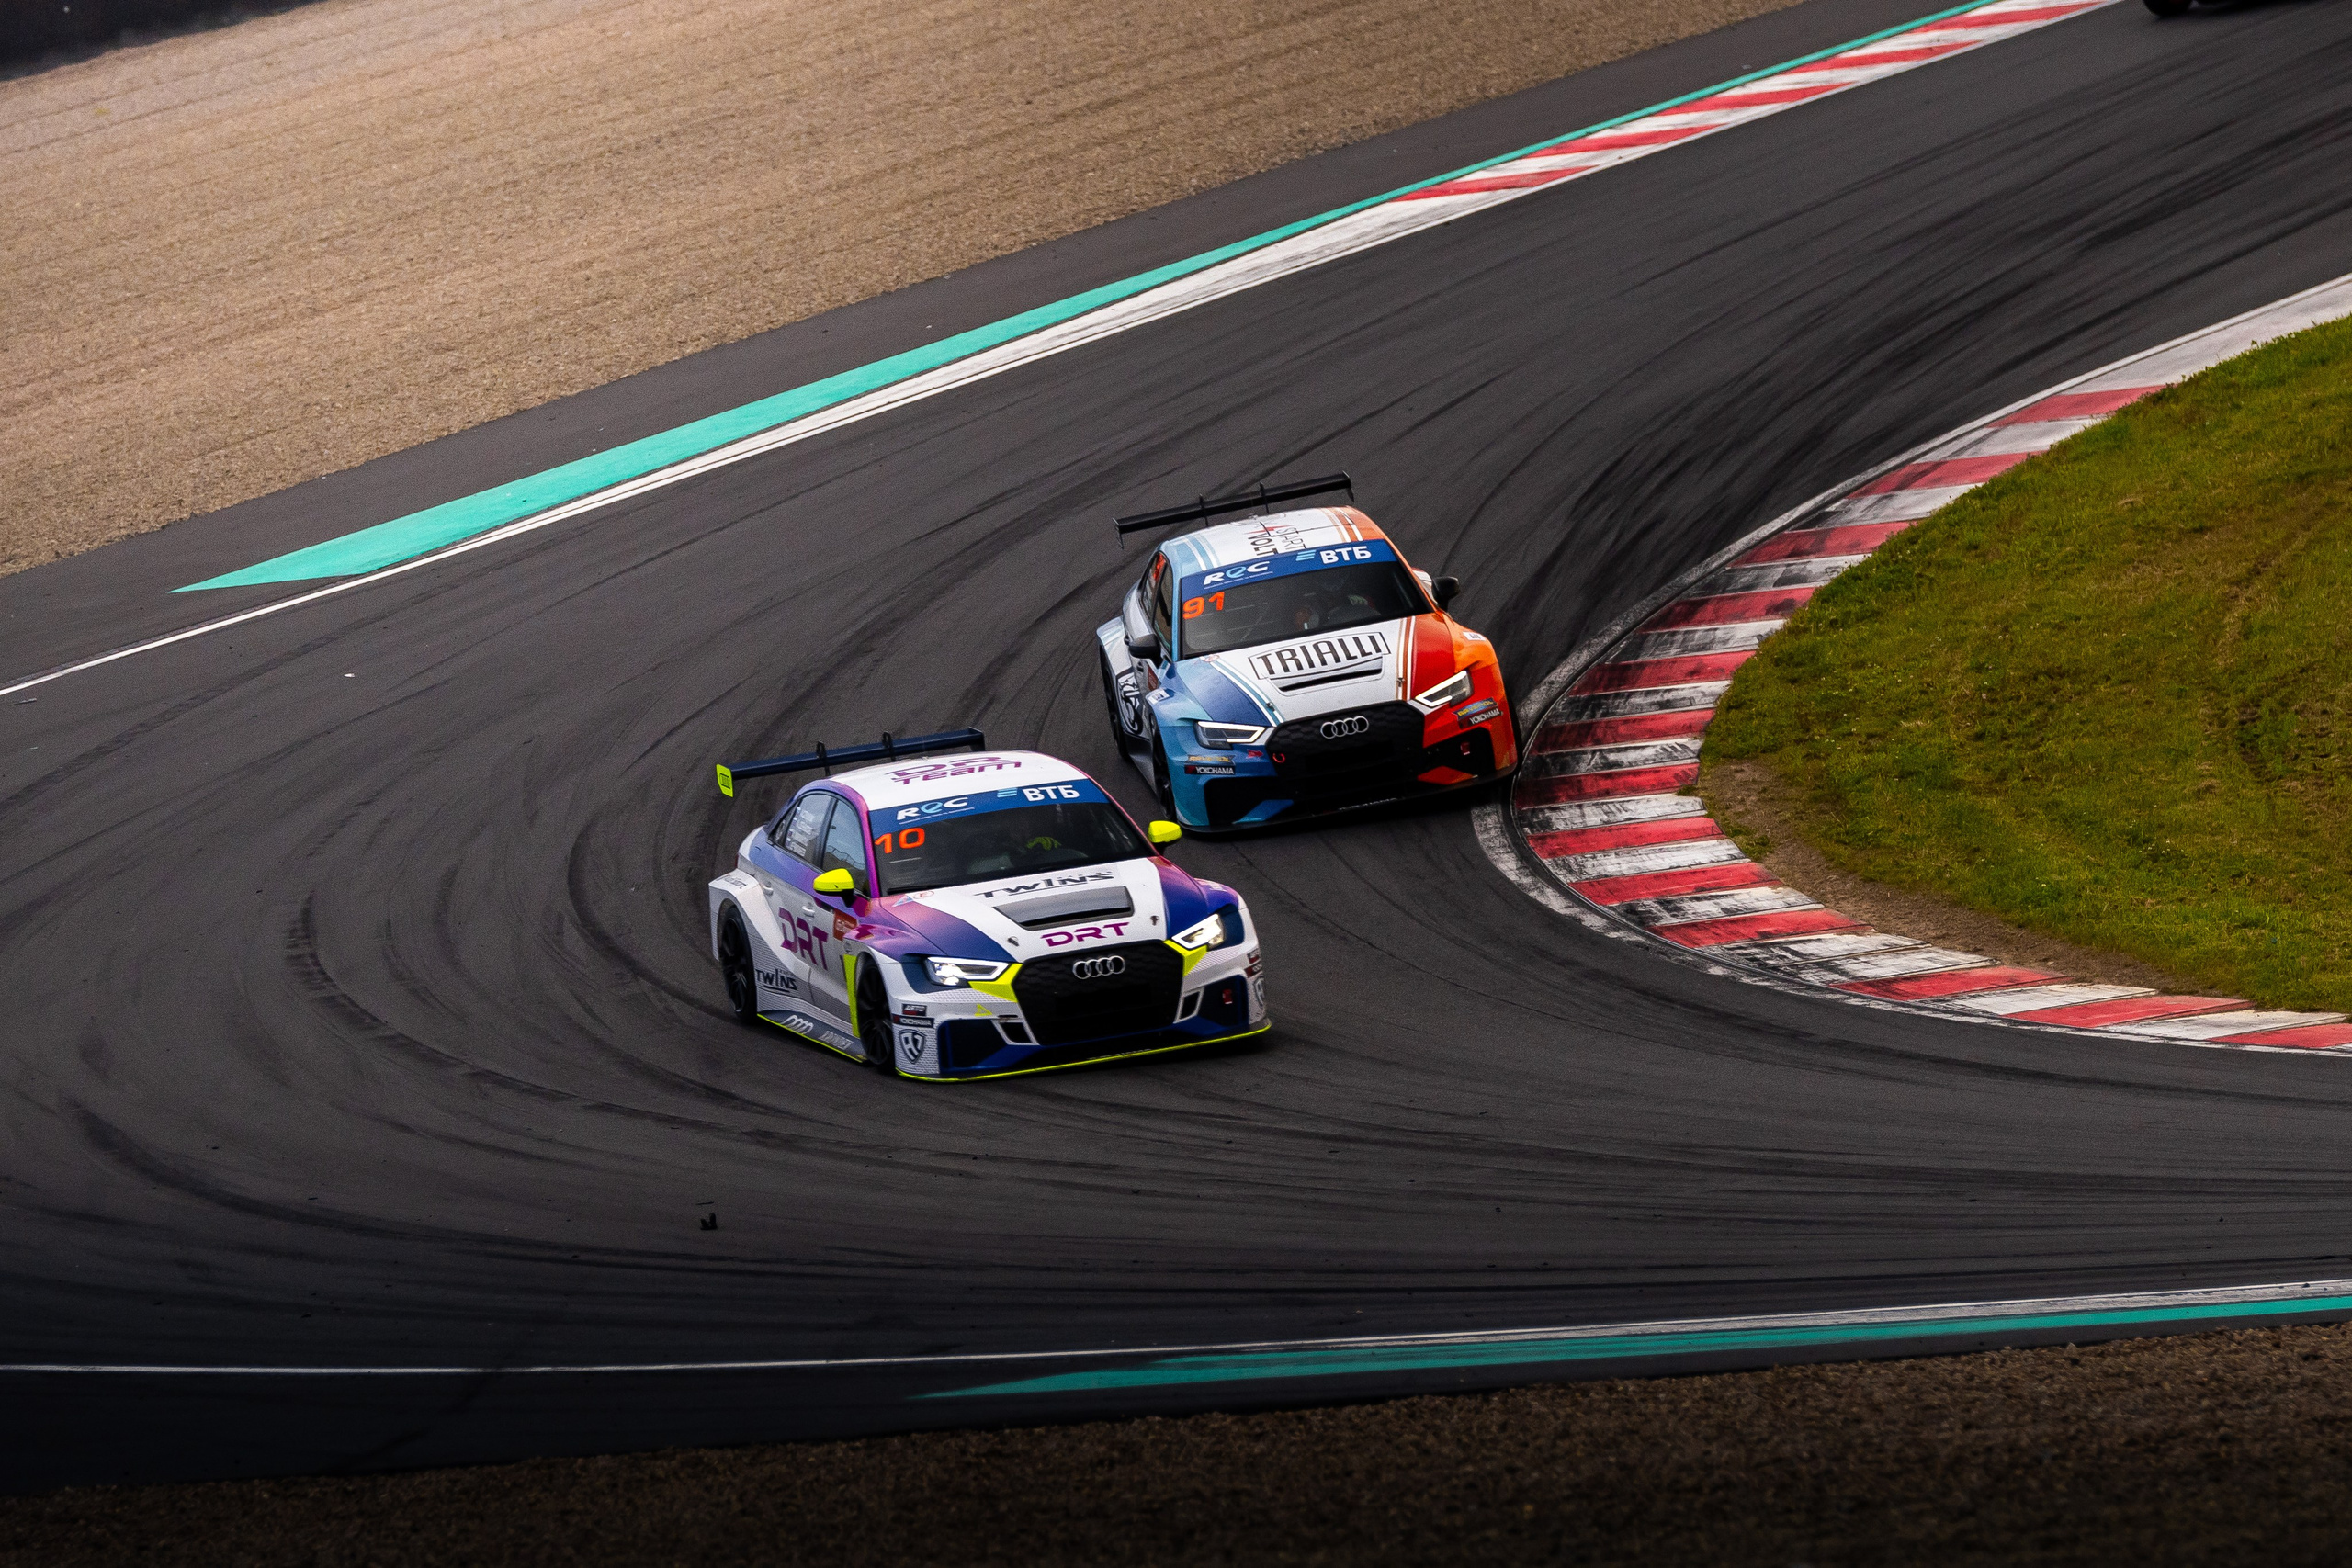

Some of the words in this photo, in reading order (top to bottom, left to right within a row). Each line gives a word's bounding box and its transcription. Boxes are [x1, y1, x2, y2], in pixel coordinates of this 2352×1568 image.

[1248, 533, 1279, 556] VOLT
[1320, 546, 1372, 564] ВТБ
[1182, 592, 1225, 620] 91
[1257, 636, 1382, 675] TRIALLI
[1195, 766, 1234, 774] YOKOHAMA
[1022, 784, 1080, 802] ВТБ
[875, 828, 925, 854] 10
[974, 874, 1114, 898] TWINS
[778, 907, 828, 970] DRT
[1040, 922, 1129, 947] DRT
[754, 969, 797, 990] TWINS
